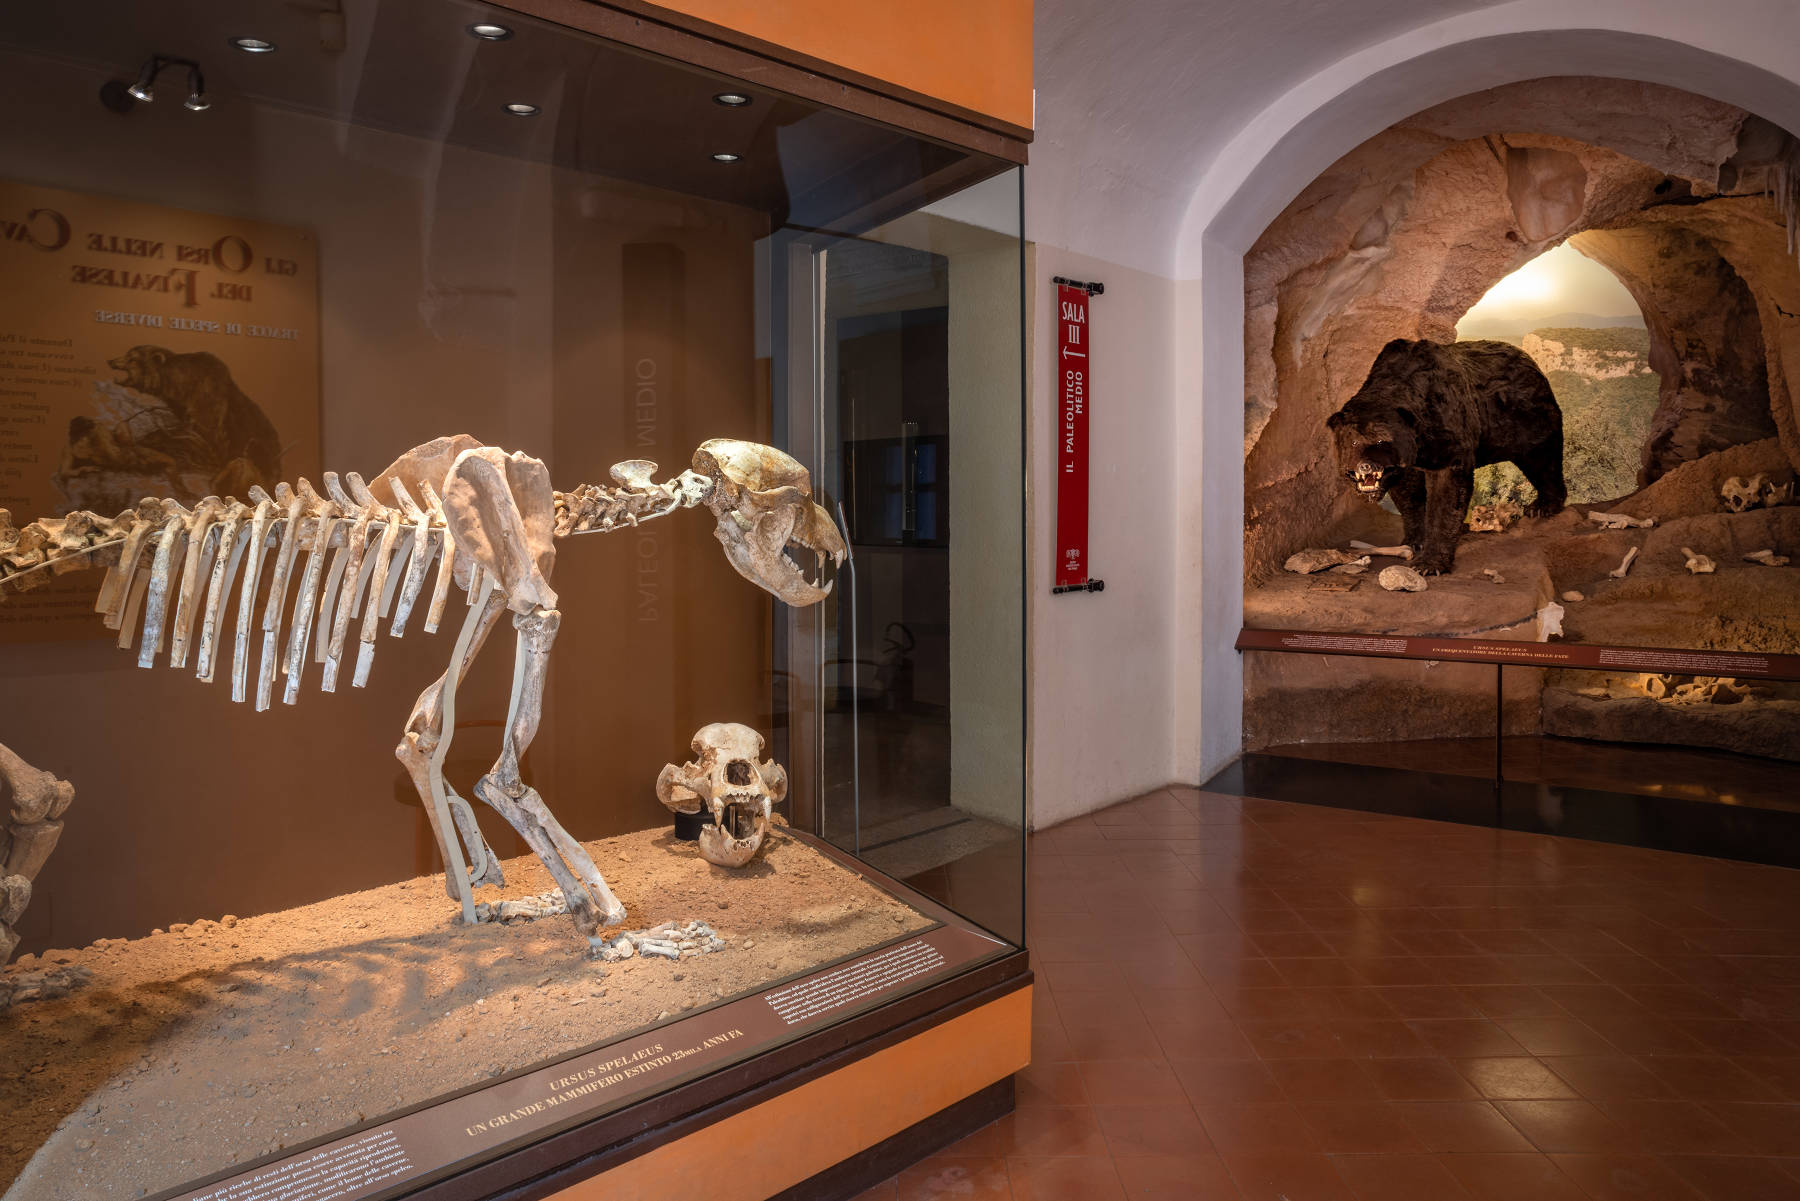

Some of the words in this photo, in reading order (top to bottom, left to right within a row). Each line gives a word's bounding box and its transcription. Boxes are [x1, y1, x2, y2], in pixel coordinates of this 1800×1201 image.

[1062, 301, 1085, 324] SALA
[1068, 324, 1080, 344] III
[1066, 370, 1074, 453] PALEOLITICO
[1075, 371, 1083, 414] MEDIO
[1066, 460, 1074, 472] IL
[466, 1122, 488, 1136] UN
[488, 1101, 546, 1128] GRANDE
[546, 1073, 624, 1108] MAMMIFERO
[624, 1055, 672, 1079] ESTINTO
[703, 1033, 730, 1050] ANNI
[728, 1028, 744, 1040] FA
[549, 1067, 596, 1091] URSUS
[598, 1043, 664, 1074] SPELAEUS
